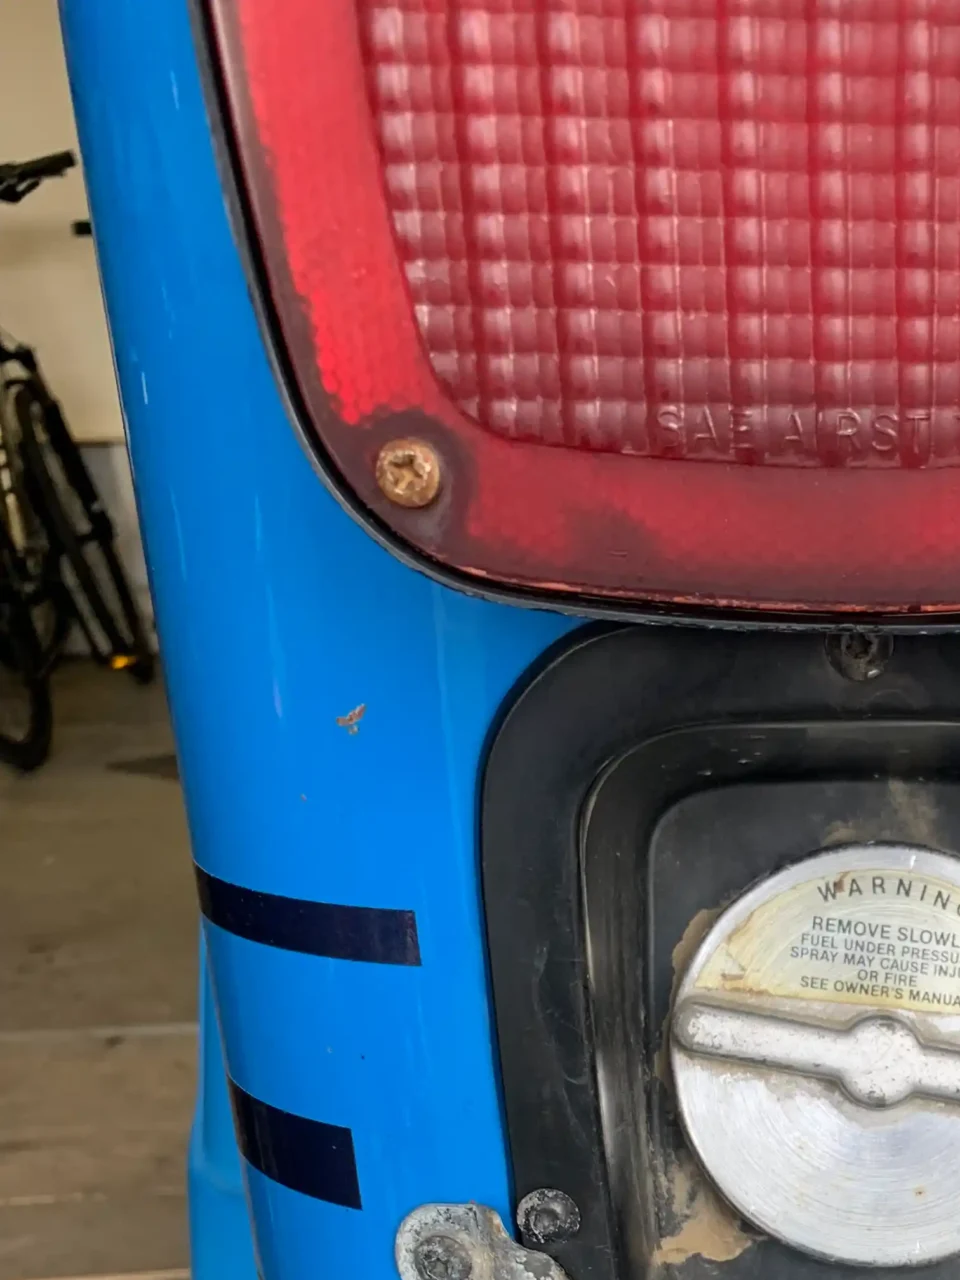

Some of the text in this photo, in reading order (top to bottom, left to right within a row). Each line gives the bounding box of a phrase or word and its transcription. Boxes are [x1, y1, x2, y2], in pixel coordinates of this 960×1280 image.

[656, 404, 756, 450] SAE
[812, 916, 891, 940] REMOVE
[801, 933, 838, 950] FUEL
[844, 938, 896, 957] UNDER
[790, 946, 838, 964] SPRAY
[843, 952, 875, 969] MAY
[880, 957, 928, 976] CAUSE
[800, 975, 828, 991] SEE
[833, 979, 904, 1000] OWNER'S
[857, 969, 918, 989] OR FIRE
